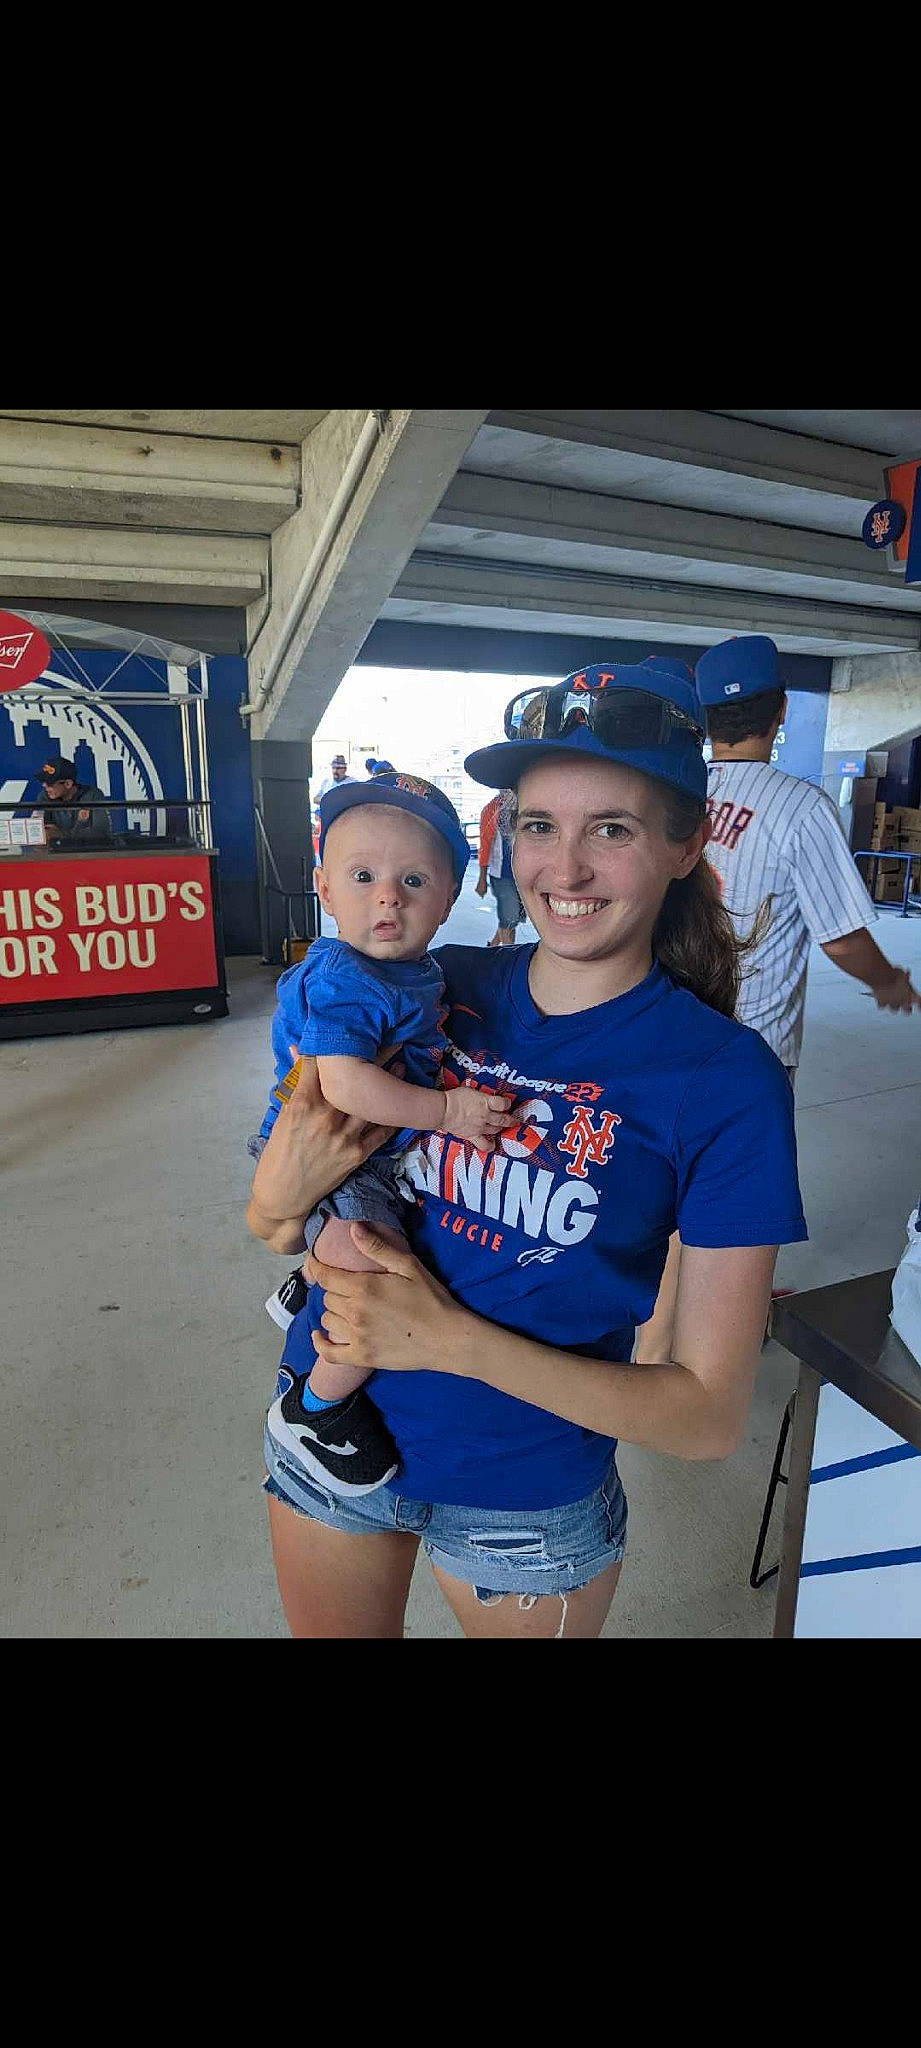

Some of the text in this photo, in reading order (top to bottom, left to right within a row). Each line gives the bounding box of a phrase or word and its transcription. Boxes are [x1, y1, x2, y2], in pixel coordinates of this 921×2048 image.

[706, 799, 755, 851] OR
[75, 881, 206, 926] BUD'S
[68, 928, 157, 972] YOU
[439, 1210, 503, 1252] LUCIE
